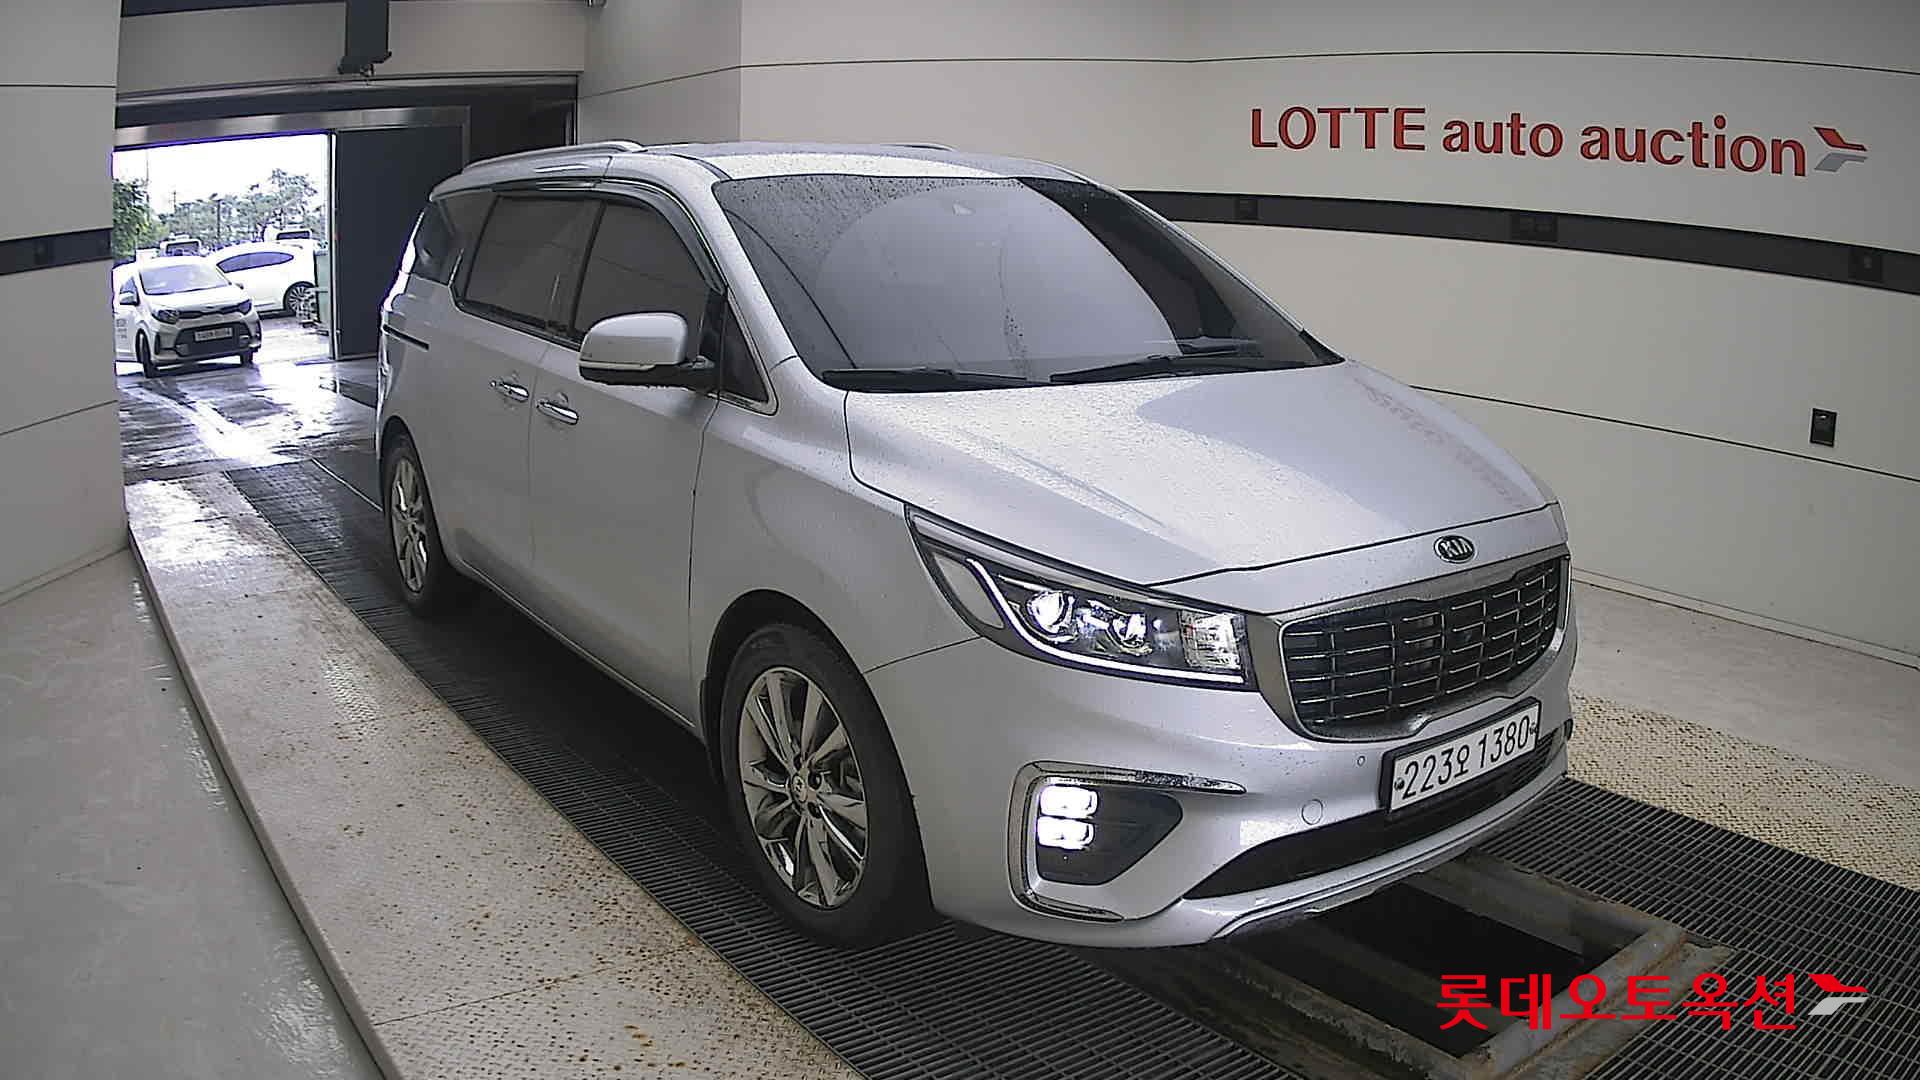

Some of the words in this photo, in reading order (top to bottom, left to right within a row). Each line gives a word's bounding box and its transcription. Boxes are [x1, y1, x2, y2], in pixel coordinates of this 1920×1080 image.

[1251, 107, 1426, 151] LOTTE
[1442, 112, 1564, 157] auto
[1580, 115, 1807, 177] auction
[1402, 744, 1470, 800] 223오
[1478, 715, 1530, 769] 1380
